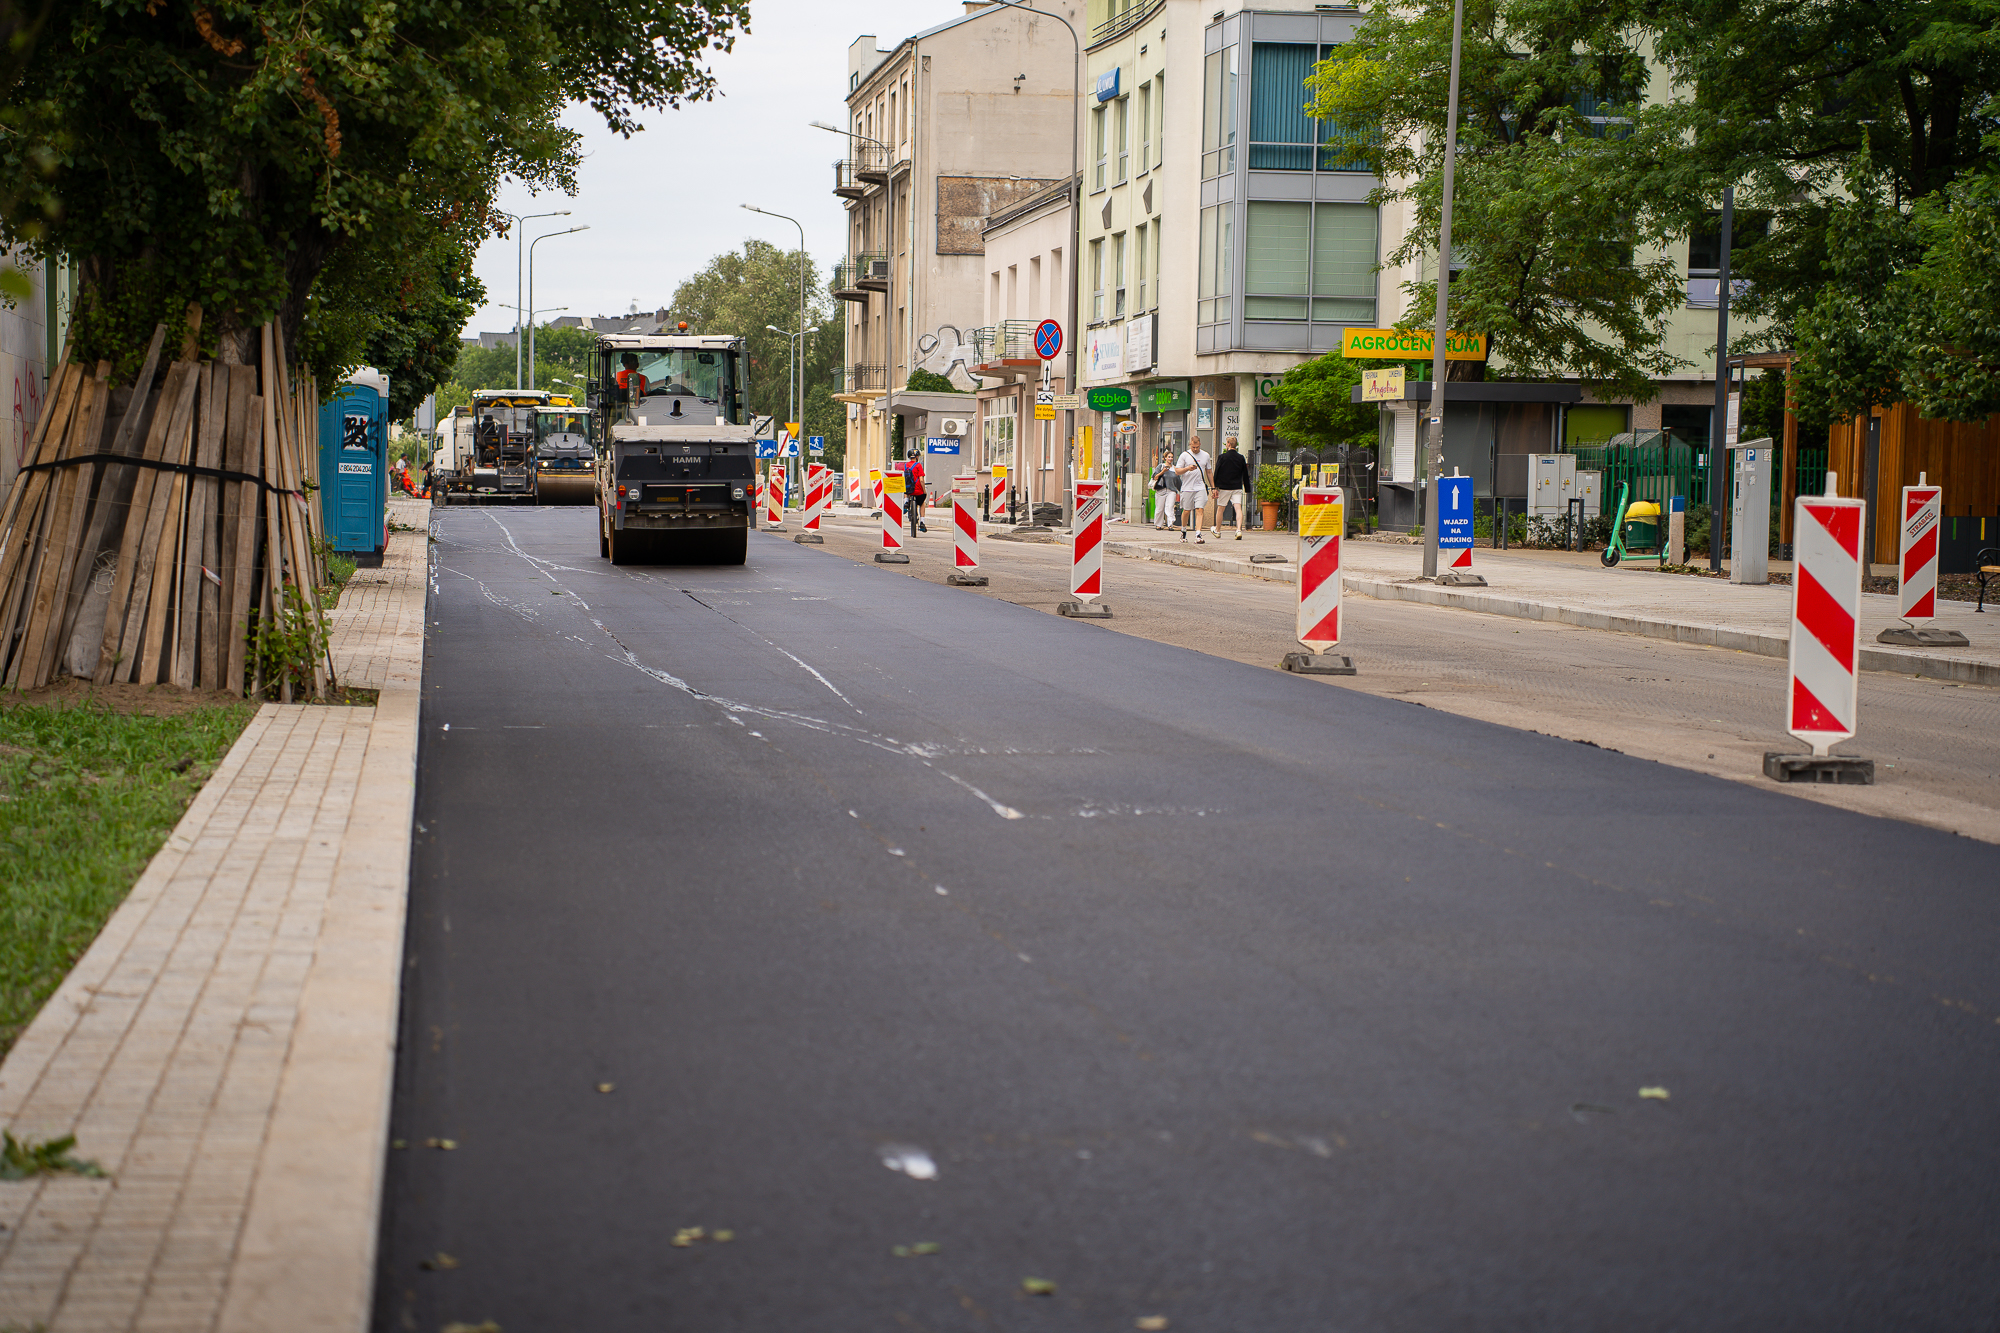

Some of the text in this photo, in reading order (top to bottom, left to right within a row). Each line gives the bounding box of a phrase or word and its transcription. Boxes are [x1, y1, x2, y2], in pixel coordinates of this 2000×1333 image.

[1198, 381, 1215, 397] 40
[1092, 392, 1128, 404] żabka
[928, 438, 958, 447] PARKING
[1080, 499, 1100, 520] STRABAG
[1909, 512, 1934, 535] STRABAG
